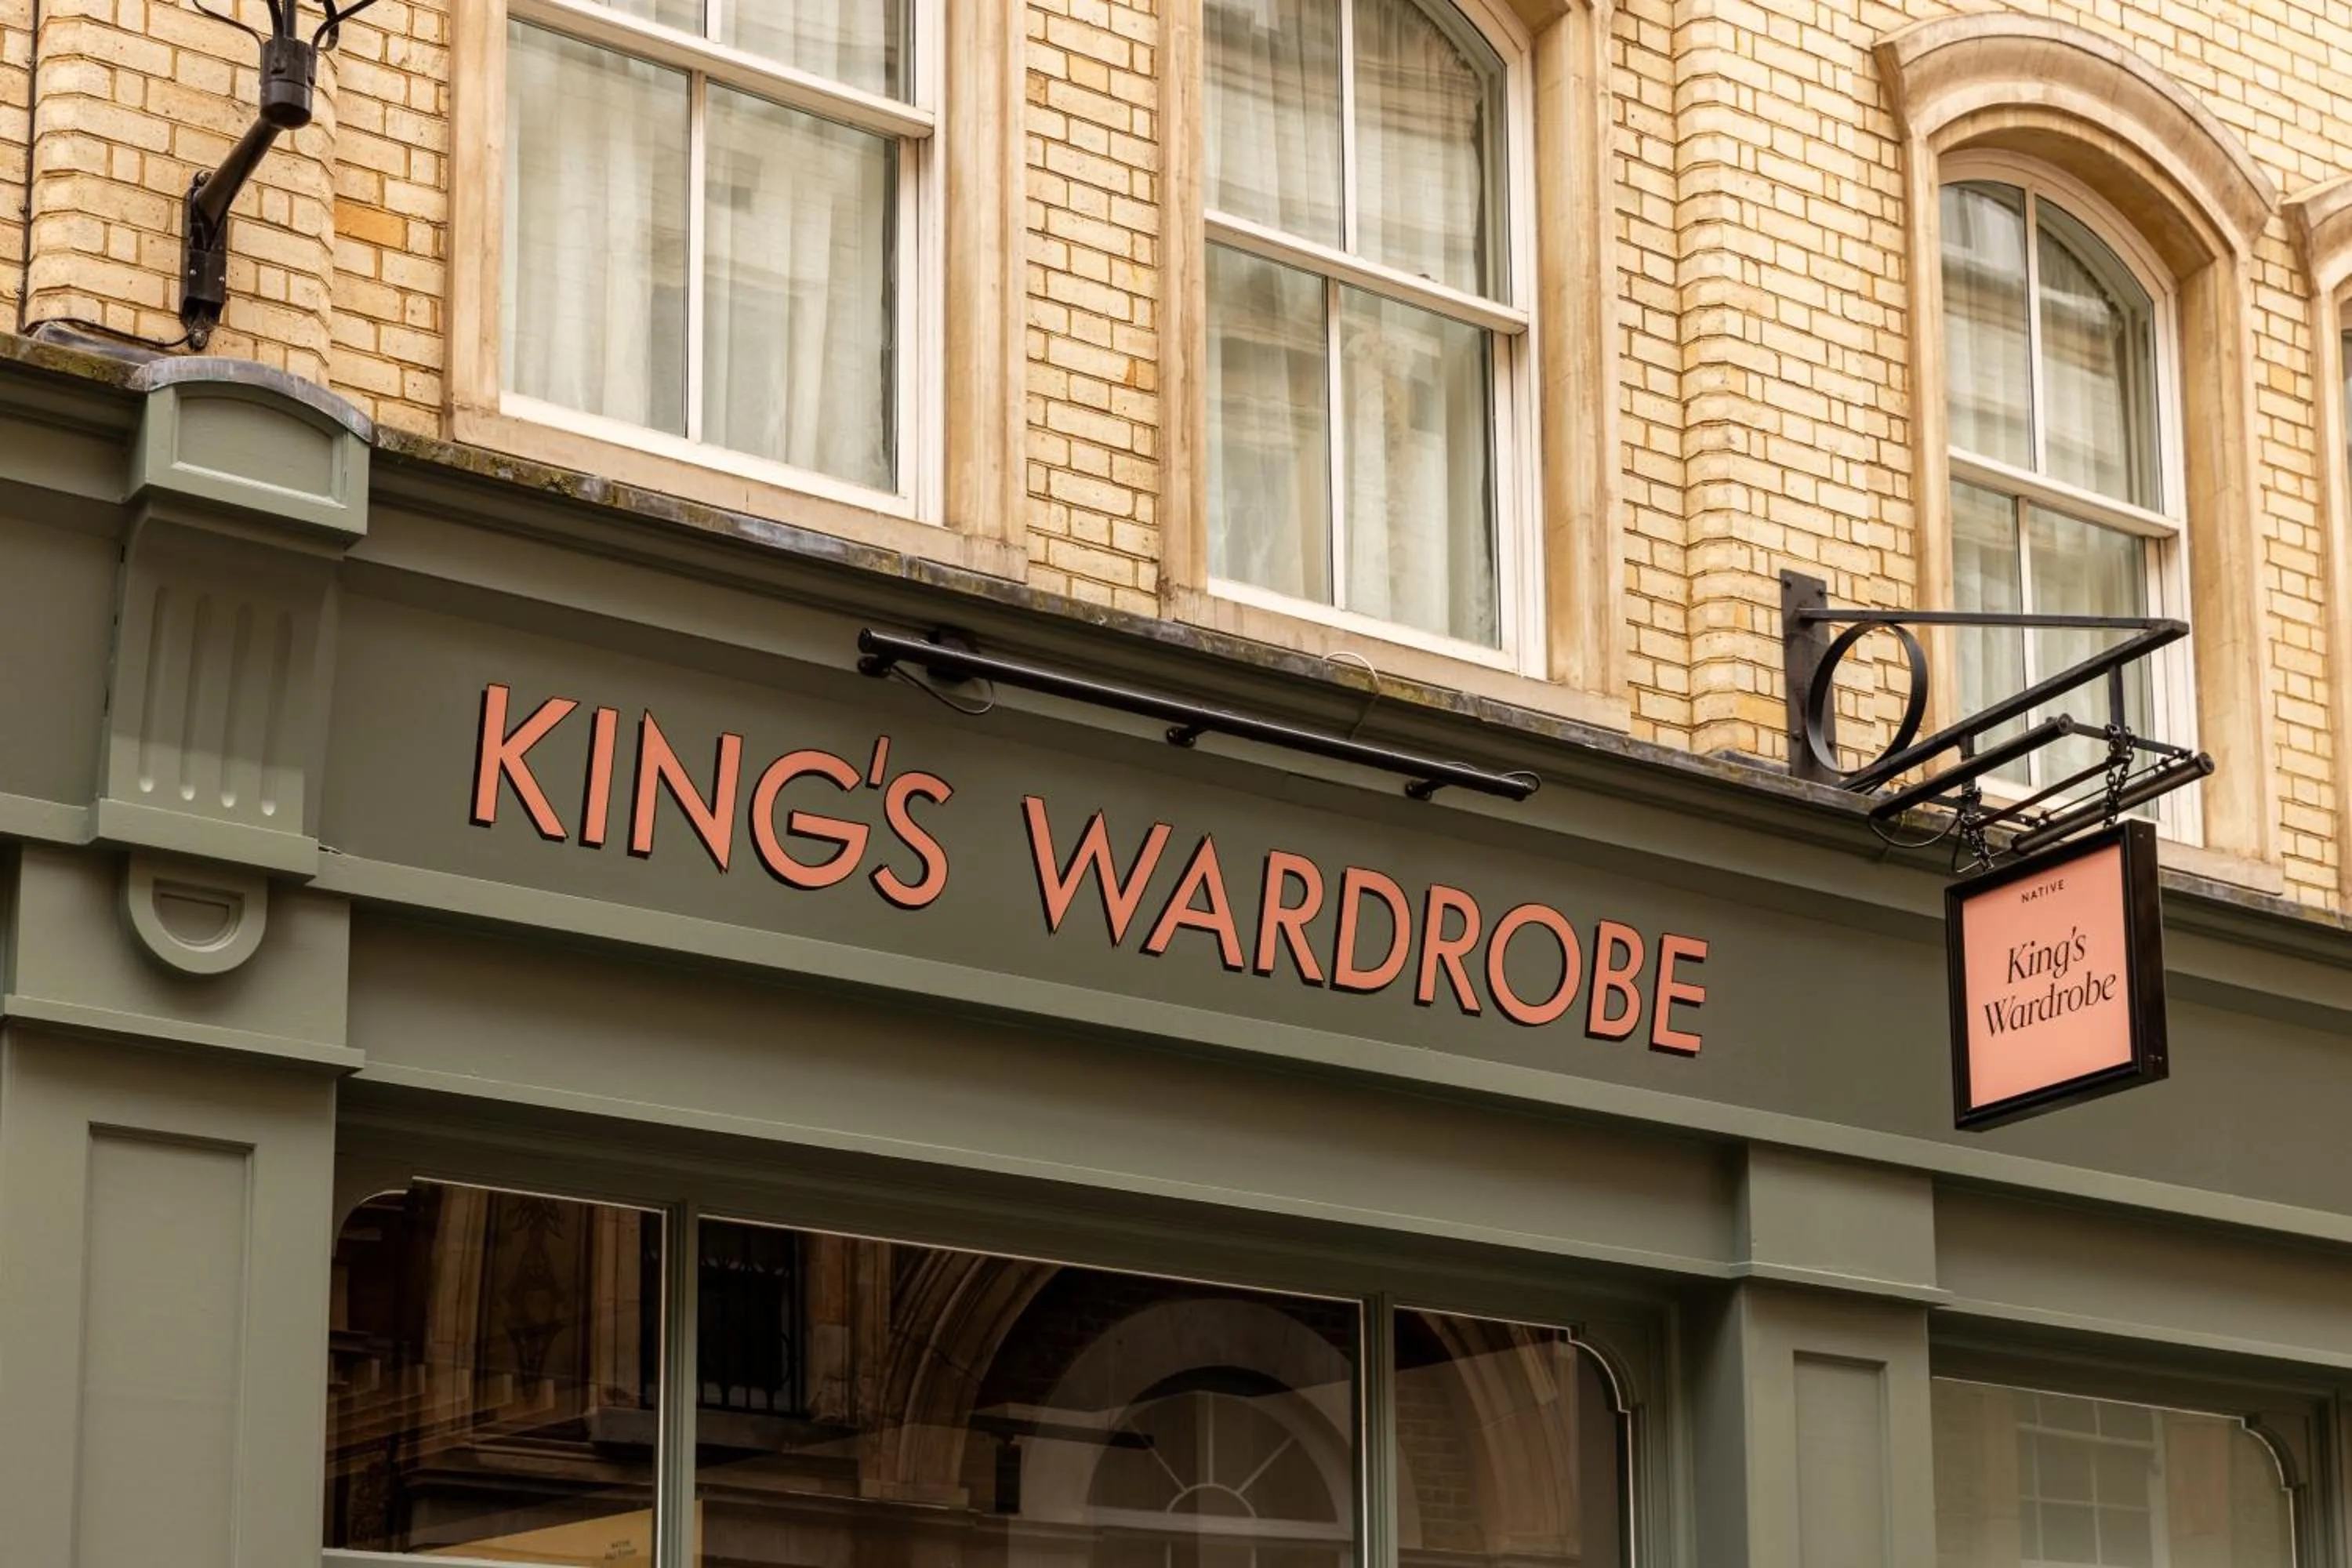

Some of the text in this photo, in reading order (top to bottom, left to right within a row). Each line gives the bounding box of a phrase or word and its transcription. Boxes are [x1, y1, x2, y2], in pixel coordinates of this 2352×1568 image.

[470, 684, 1709, 1055] KING'S WARDROBE
[2021, 879, 2064, 903] NATIVE
[2007, 926, 2086, 984] King's
[1984, 971, 2116, 1037] Wardrobe
